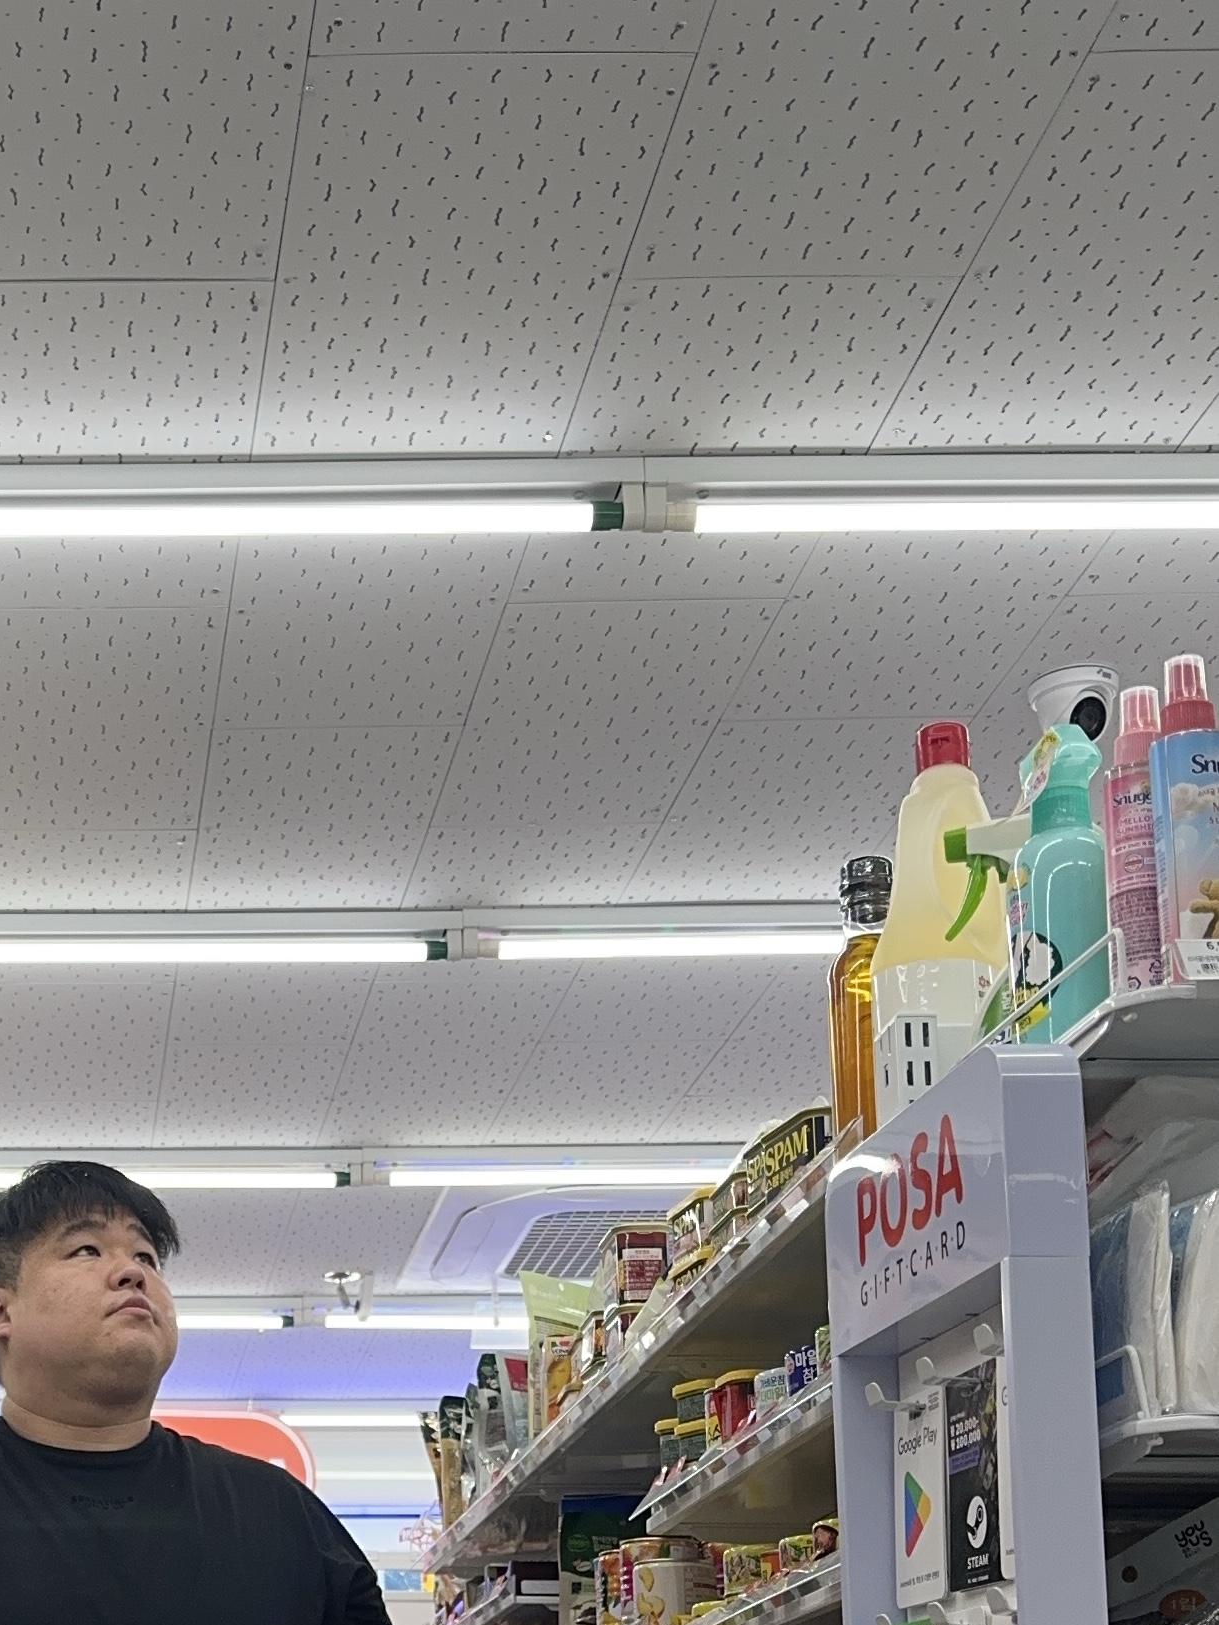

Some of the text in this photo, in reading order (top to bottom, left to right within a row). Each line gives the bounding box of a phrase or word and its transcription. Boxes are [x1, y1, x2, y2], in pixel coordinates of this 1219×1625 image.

[764, 1124, 809, 1177] SPAM
[857, 1114, 963, 1267] POSA
[898, 1427, 938, 1456] Google Play
[967, 1553, 989, 1570] STEAM
